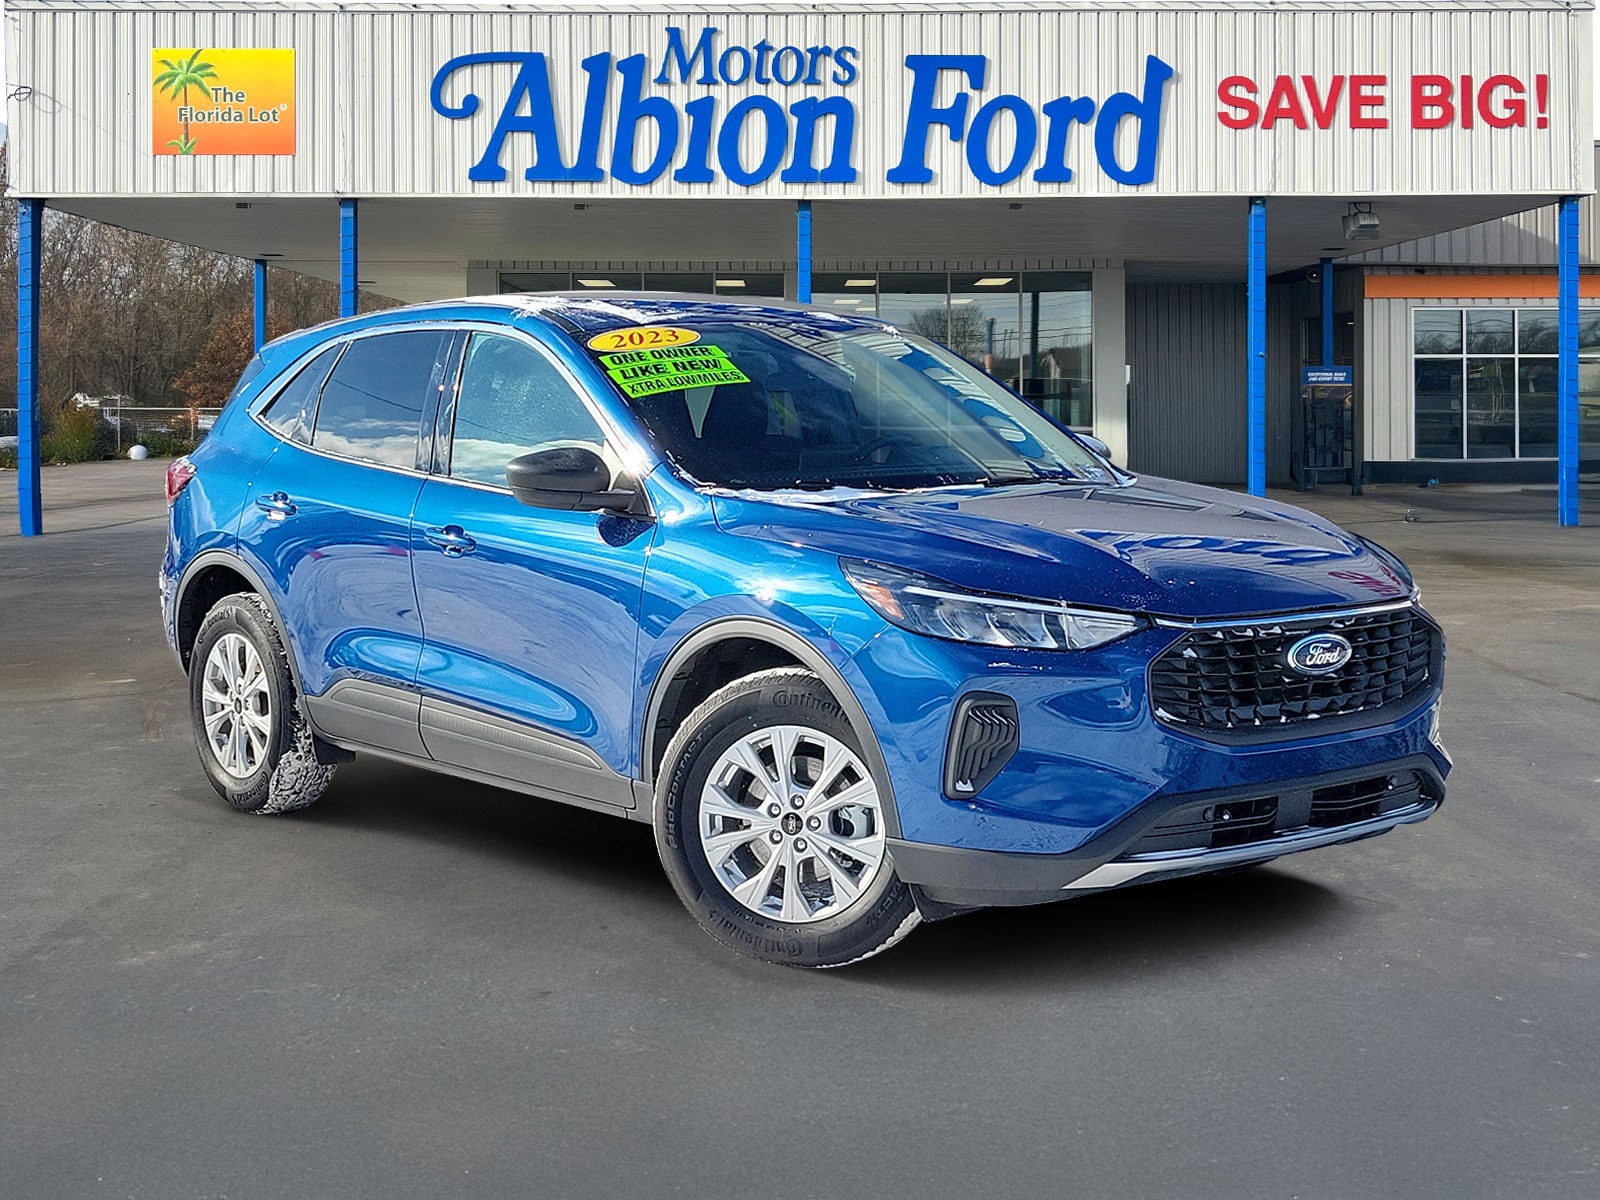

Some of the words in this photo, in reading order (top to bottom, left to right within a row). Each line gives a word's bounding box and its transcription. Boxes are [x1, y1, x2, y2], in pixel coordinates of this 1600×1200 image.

[655, 28, 857, 84] Motors
[211, 86, 246, 103] The
[1217, 75, 1388, 129] SAVE
[1411, 75, 1549, 129] BIG!
[178, 106, 243, 122] Florida
[248, 106, 279, 122] Lot
[430, 52, 857, 186] Albion
[886, 55, 1173, 186] Ford
[610, 330, 679, 348] 2023
[610, 352, 648, 365] ONE
[650, 346, 713, 361] OWNER
[619, 363, 667, 380] LIKE
[674, 358, 720, 372] NEW
[628, 379, 666, 394] XTRA
[1305, 642, 1342, 666] Ford
